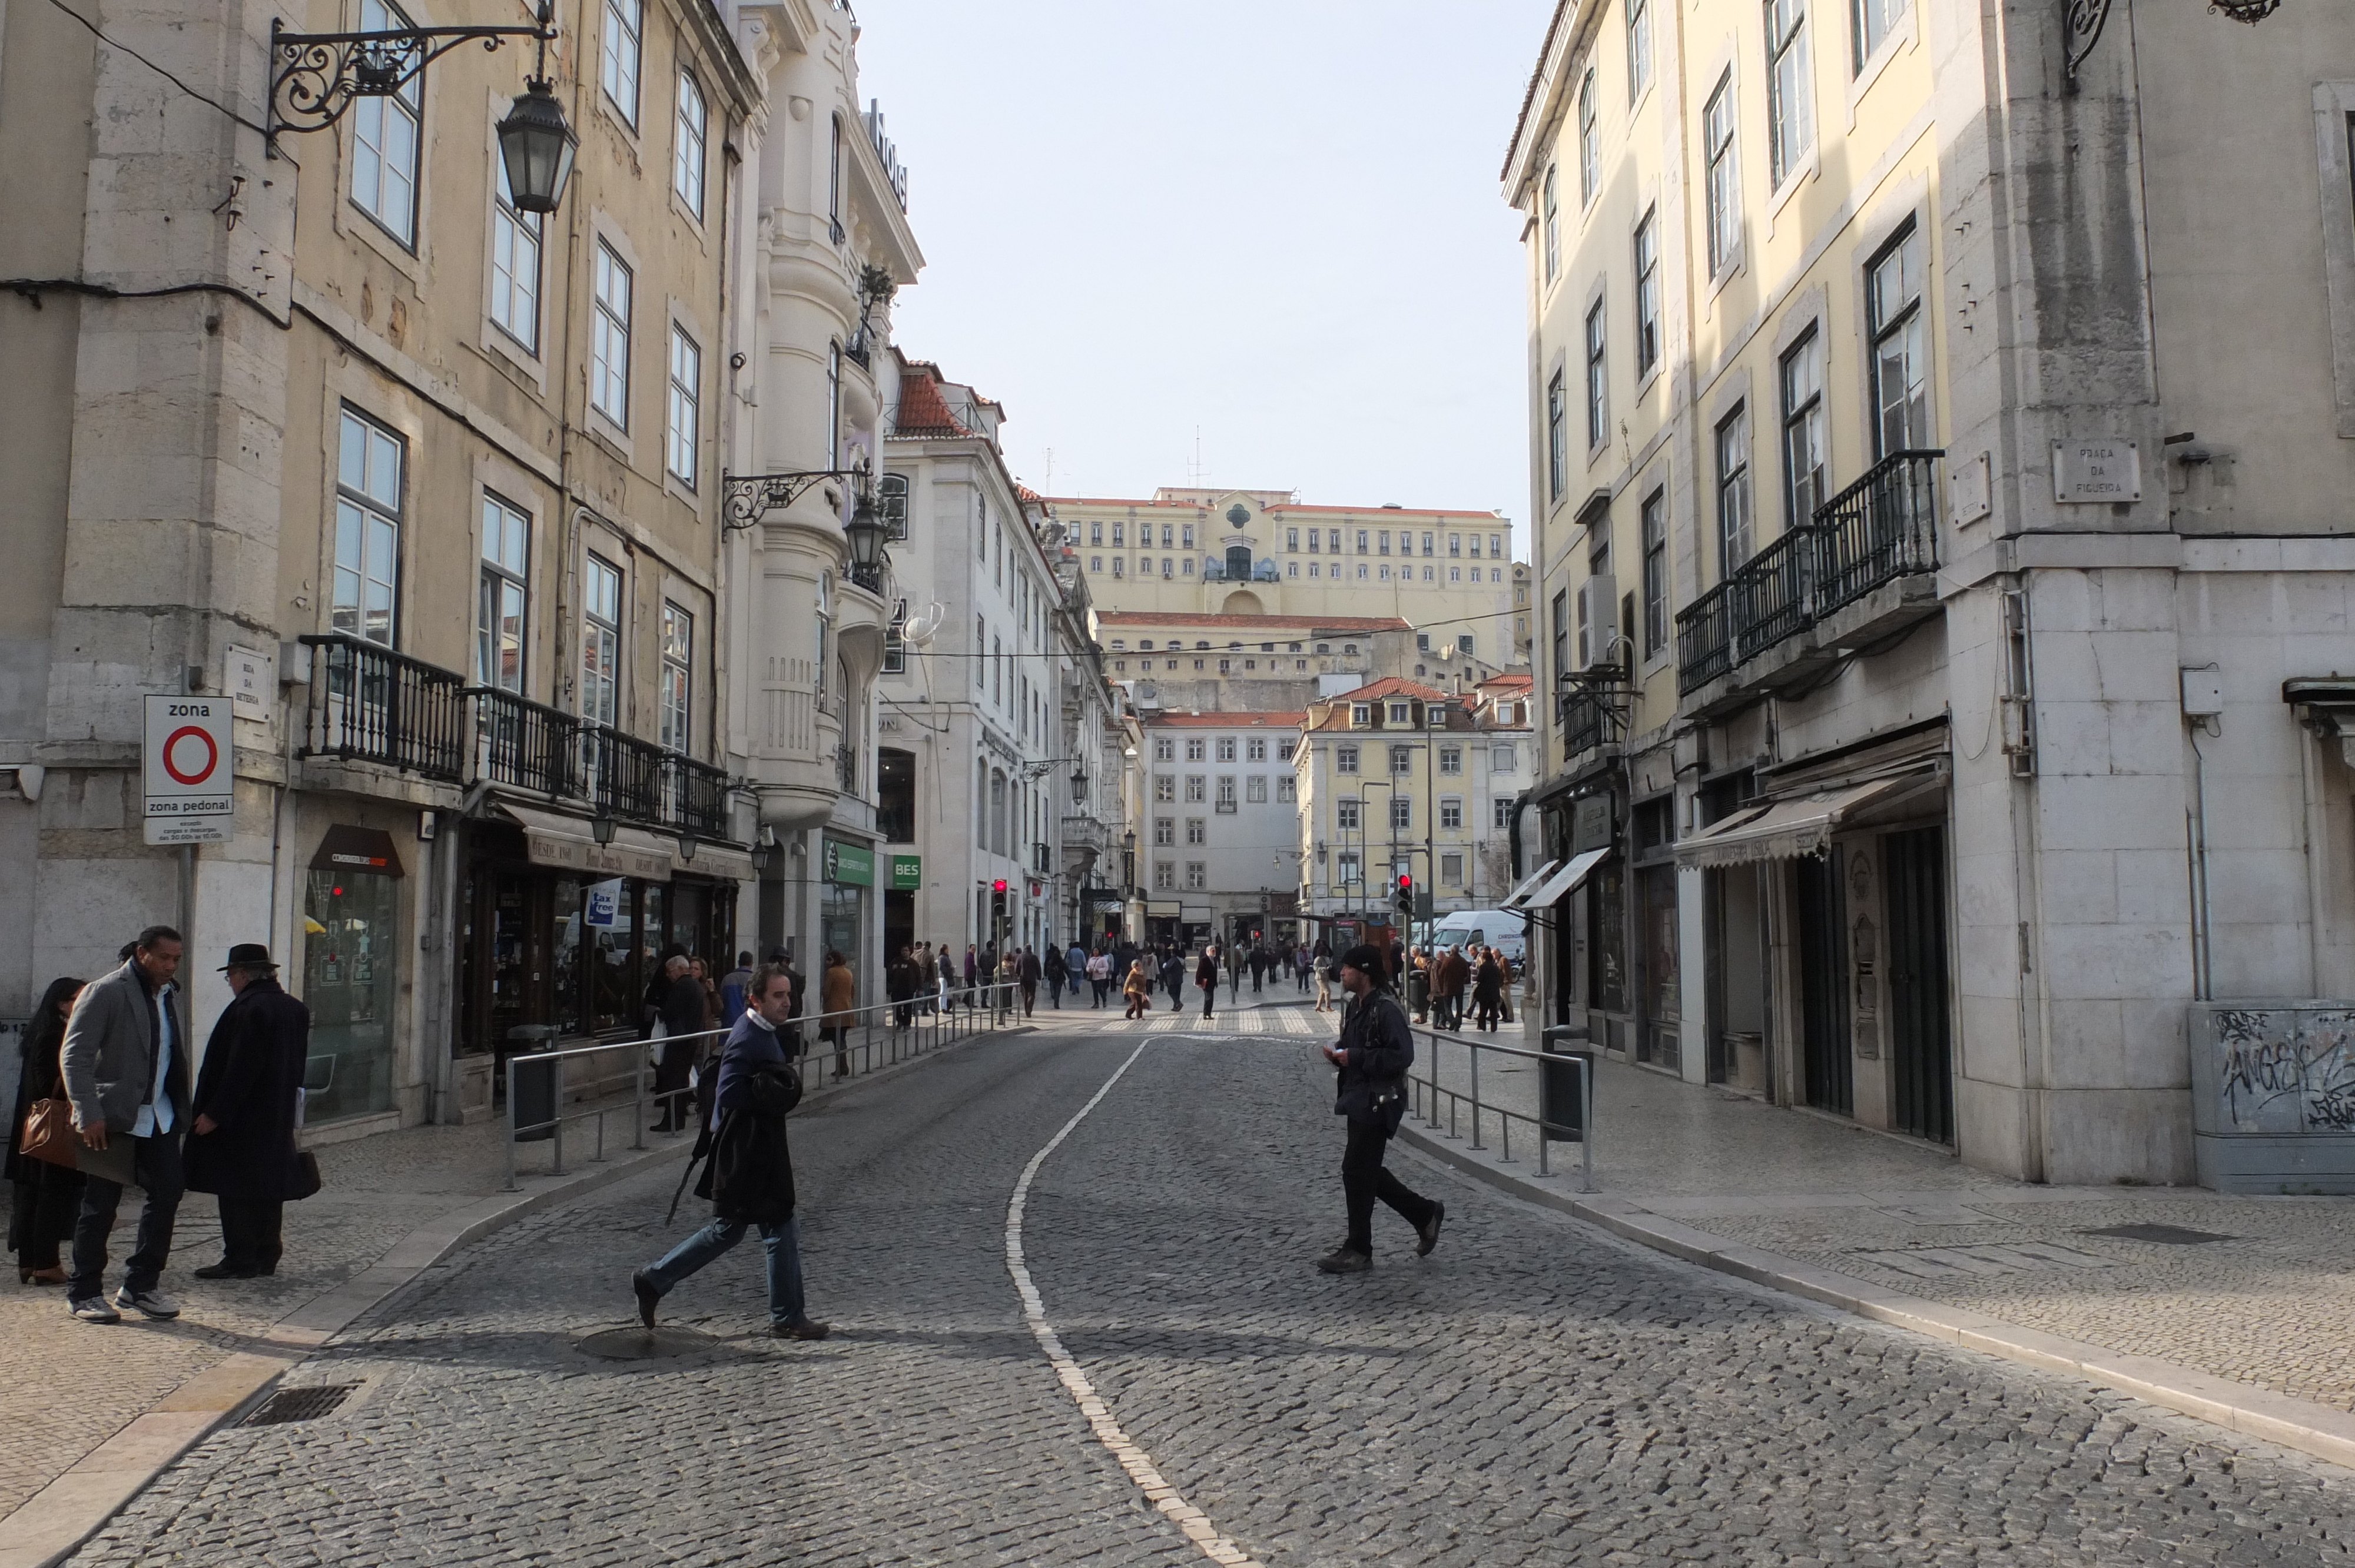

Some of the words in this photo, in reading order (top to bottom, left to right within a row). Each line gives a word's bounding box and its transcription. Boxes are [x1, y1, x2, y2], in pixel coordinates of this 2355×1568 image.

[2091, 466, 2105, 476] DA
[2077, 483, 2121, 493] FIGUEIRA
[169, 705, 210, 716] zona
[150, 803, 178, 812] zona
[183, 799, 229, 812] pedonal
[531, 841, 556, 858] DESDE
[895, 864, 919, 876] BES
[593, 892, 611, 902] tax
[594, 902, 613, 911] free
